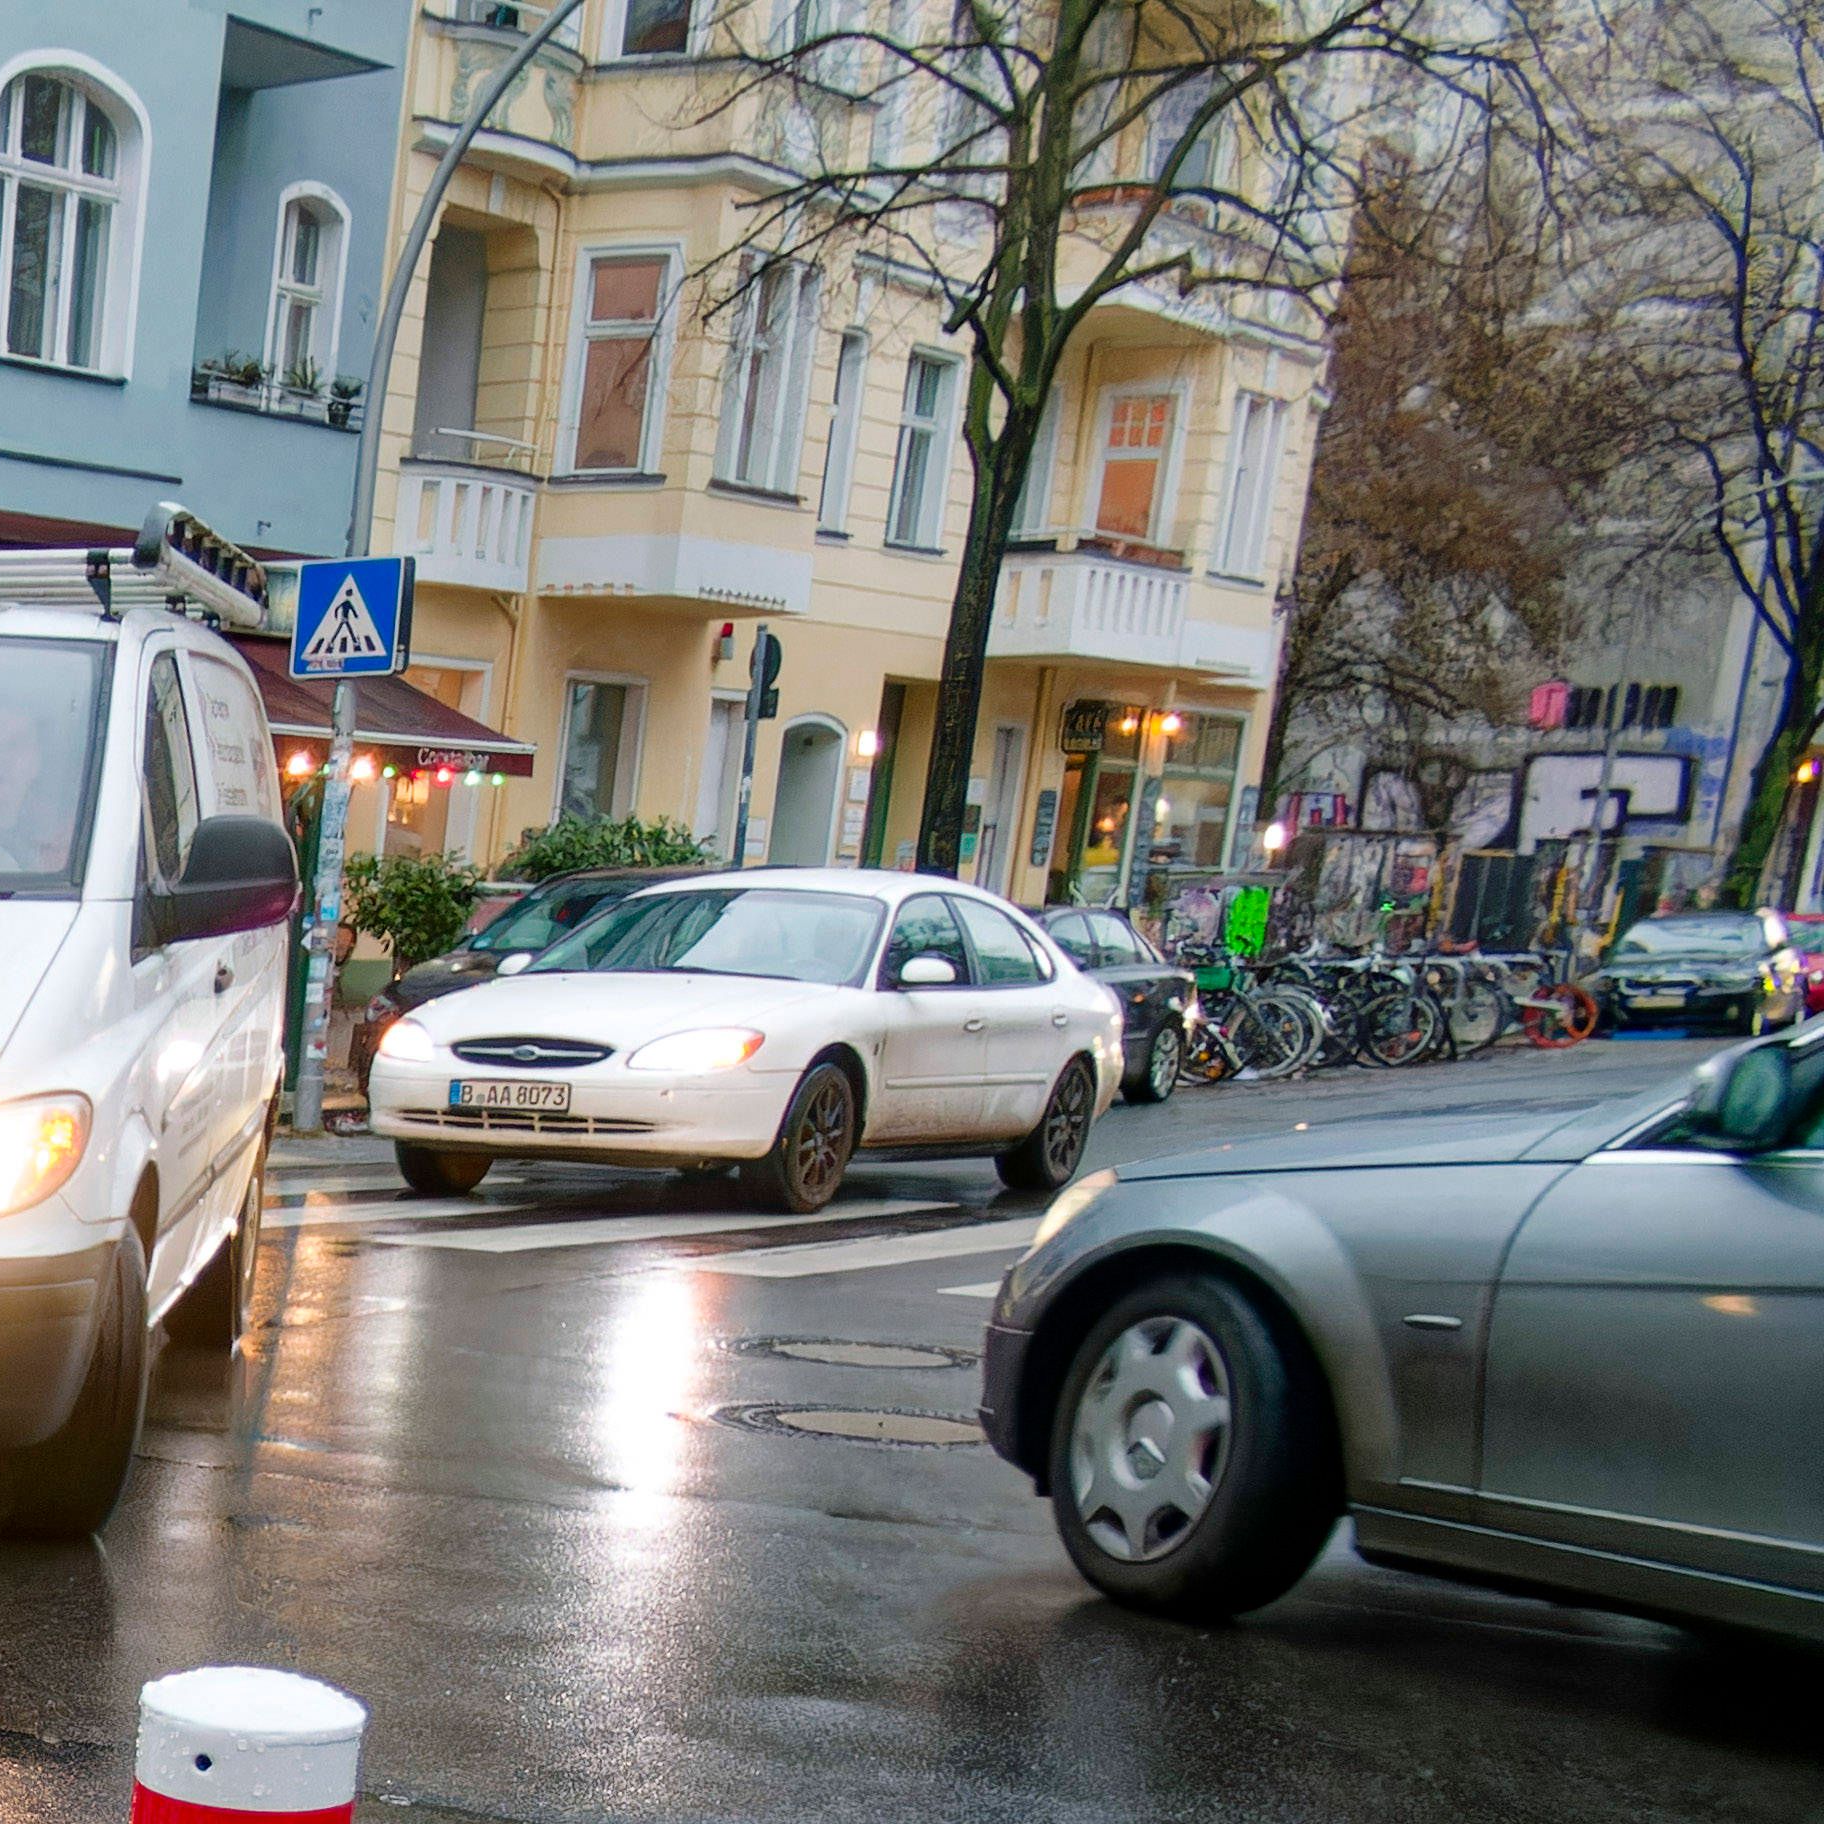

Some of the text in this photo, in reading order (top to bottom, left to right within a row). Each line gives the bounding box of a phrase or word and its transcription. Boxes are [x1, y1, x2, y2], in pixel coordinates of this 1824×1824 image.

[460, 1084, 566, 1106] B AA 8073
